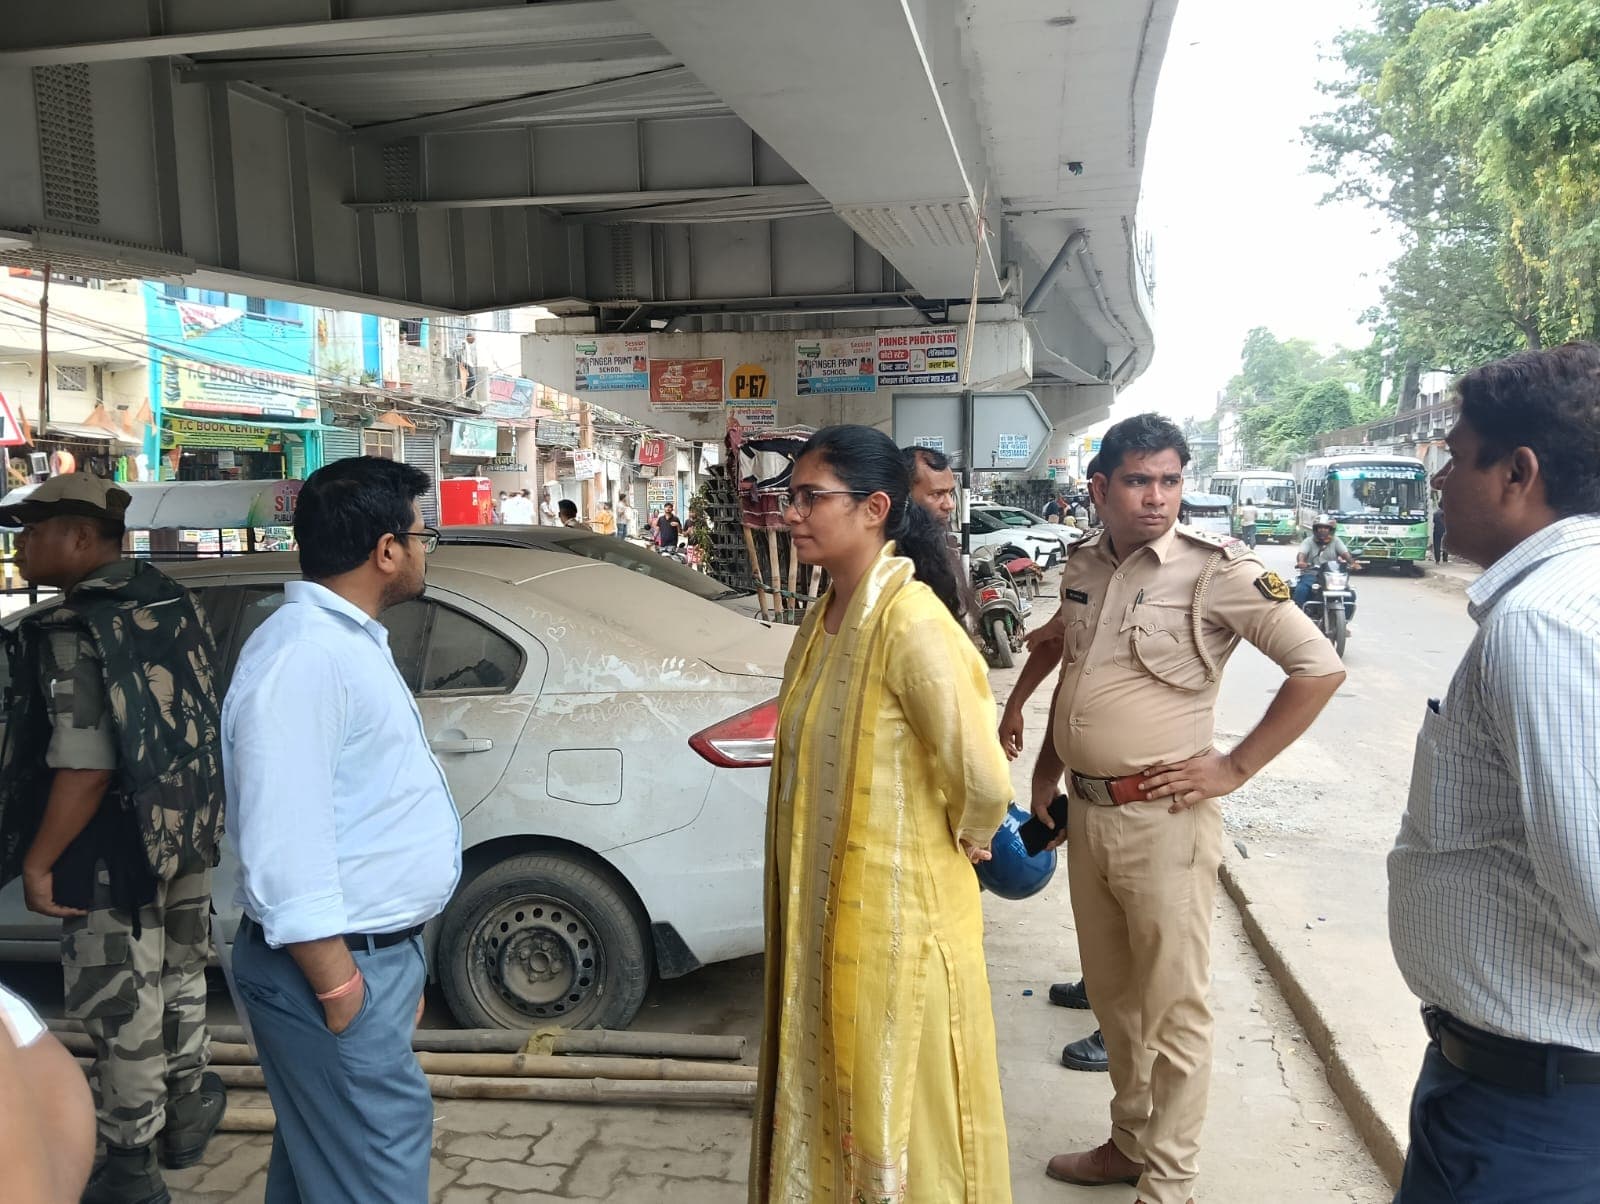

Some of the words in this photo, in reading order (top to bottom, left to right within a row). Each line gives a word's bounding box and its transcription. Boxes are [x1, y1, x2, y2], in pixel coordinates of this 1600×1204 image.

[879, 336, 908, 347] PRINCE
[909, 335, 936, 345] PHOTO
[937, 333, 957, 344] STAT
[590, 356, 612, 366] FINGER
[614, 356, 633, 365] PRINT
[812, 359, 837, 369] FINGER
[839, 358, 858, 368] PRINT
[209, 365, 249, 385] BOOK
[250, 371, 297, 390] CENTRE
[736, 375, 766, 399] P-67
[197, 421, 226, 432] BOOK
[229, 423, 266, 434] CENTRE
